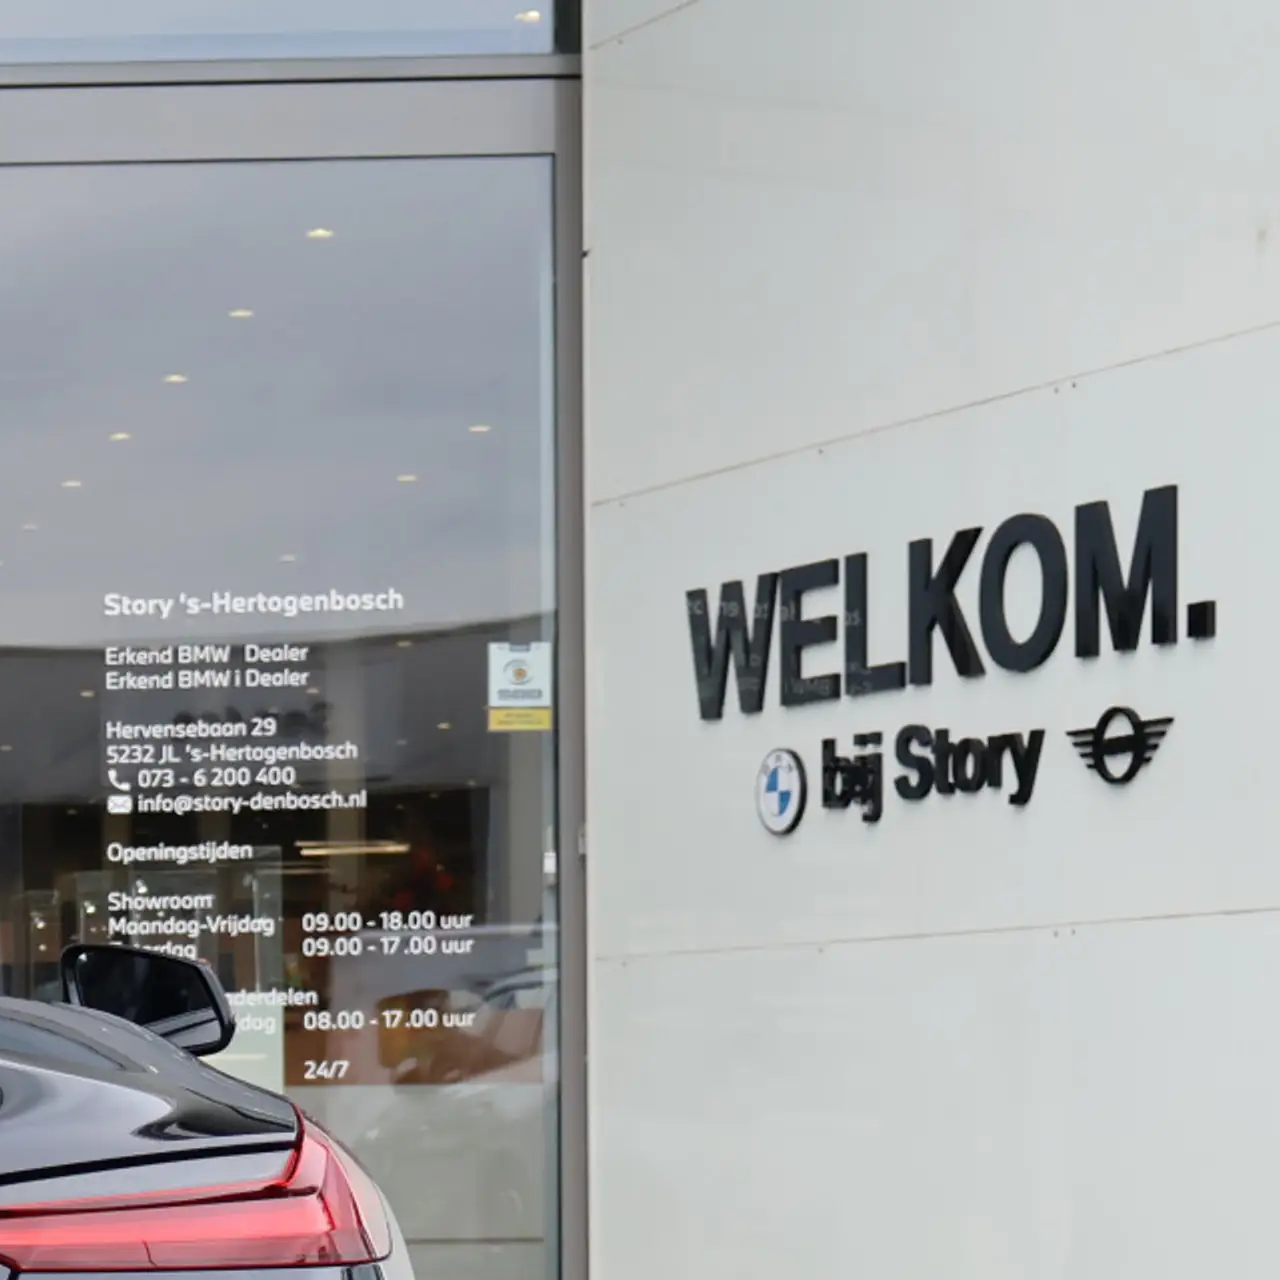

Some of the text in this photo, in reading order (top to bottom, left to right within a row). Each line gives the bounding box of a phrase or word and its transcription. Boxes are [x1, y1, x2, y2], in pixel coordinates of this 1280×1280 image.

[104, 589, 403, 619] Story 's-Hertogenbosch
[686, 485, 1216, 720] WELKOM.
[105, 644, 309, 665] Erkend BMW Dealer
[105, 668, 310, 690] Erkend BMW i Dealer
[106, 717, 277, 739] Hervensebaan 29
[106, 741, 358, 765] 5232 JL 's-Hertogenbosch
[138, 769, 174, 788] 073
[193, 769, 207, 786] 6
[211, 767, 251, 786] 200
[256, 767, 296, 785] 400
[822, 724, 1045, 822] bij Story
[138, 789, 367, 815] info@story-denbosch.nl
[107, 842, 253, 865] Openingstijden
[108, 892, 214, 911] Showroom
[108, 914, 275, 938] Maandag-Vrijdag
[302, 912, 362, 932] 09.00
[379, 910, 436, 930] 18.00
[439, 914, 474, 930] uur
[302, 936, 363, 957] 09.00
[441, 938, 476, 954] uur
[304, 1010, 365, 1030] 08.00
[442, 1012, 477, 1028] uur
[304, 1060, 350, 1079] 24/7
